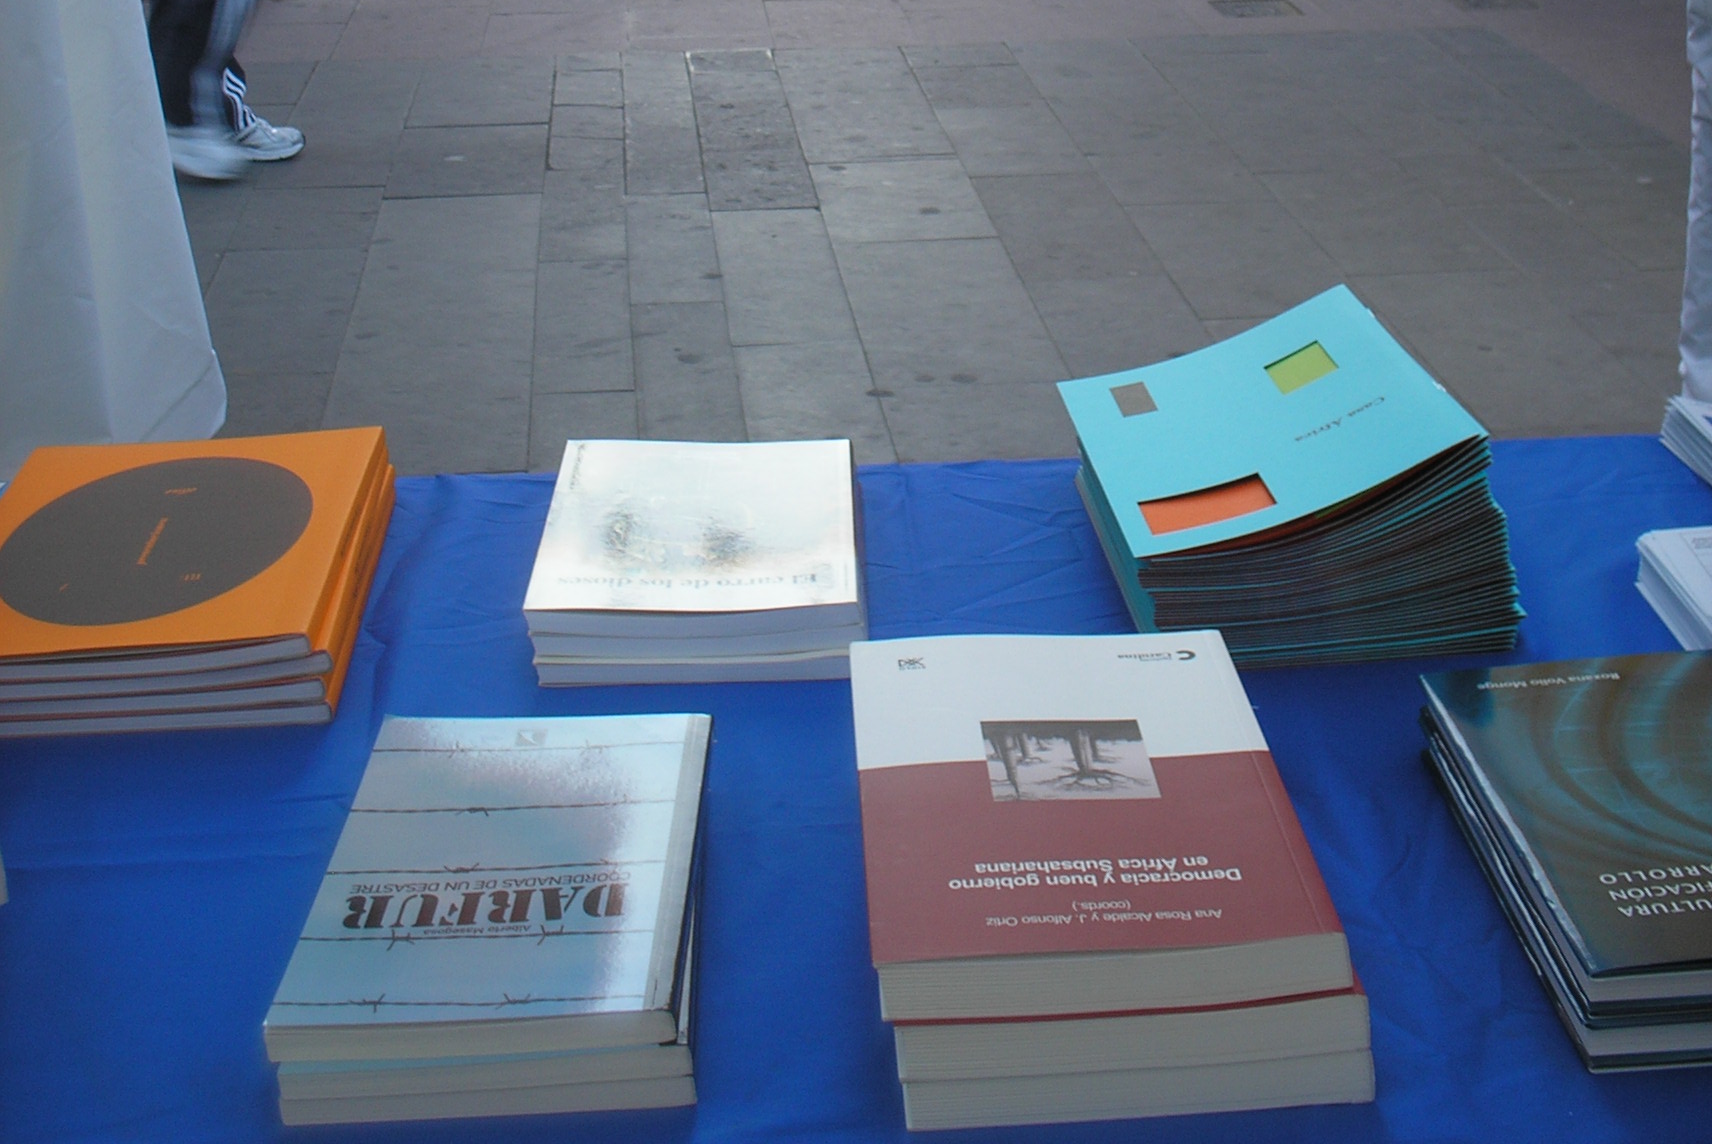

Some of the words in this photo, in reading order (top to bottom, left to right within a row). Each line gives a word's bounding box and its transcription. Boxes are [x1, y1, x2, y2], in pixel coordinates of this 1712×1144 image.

[1347, 396, 1385, 417] Casa
[640, 577, 673, 589] los
[680, 578, 709, 589] de
[716, 576, 784, 588] carro
[792, 574, 818, 585] El
[1529, 677, 1566, 687] Volio
[1567, 672, 1620, 682] Roxana
[1476, 680, 1527, 691] Monge
[974, 859, 1113, 875] Subsahariana
[1118, 857, 1177, 873] África
[1182, 856, 1208, 869] en
[502, 871, 631, 890] COORDENADAS
[947, 872, 1040, 891] gobierno
[1045, 873, 1098, 888] buen
[1102, 871, 1115, 885] y
[1120, 867, 1242, 886] Democracia
[349, 881, 440, 895] DESASTRE
[444, 881, 470, 893] UN
[474, 879, 498, 892] DE
[341, 882, 629, 930] DARFUR
[1071, 900, 1131, 911] (coords.)
[1021, 914, 1072, 926] Alfonso
[1074, 913, 1087, 923] J.
[1091, 912, 1100, 922] y
[1103, 912, 1152, 924] Alcalde
[1155, 910, 1191, 921] Rosa
[1194, 909, 1222, 919] Ana
[985, 916, 1018, 928] Ortiz
[422, 927, 485, 937] Masegosa
[487, 924, 532, 934] Alberto
